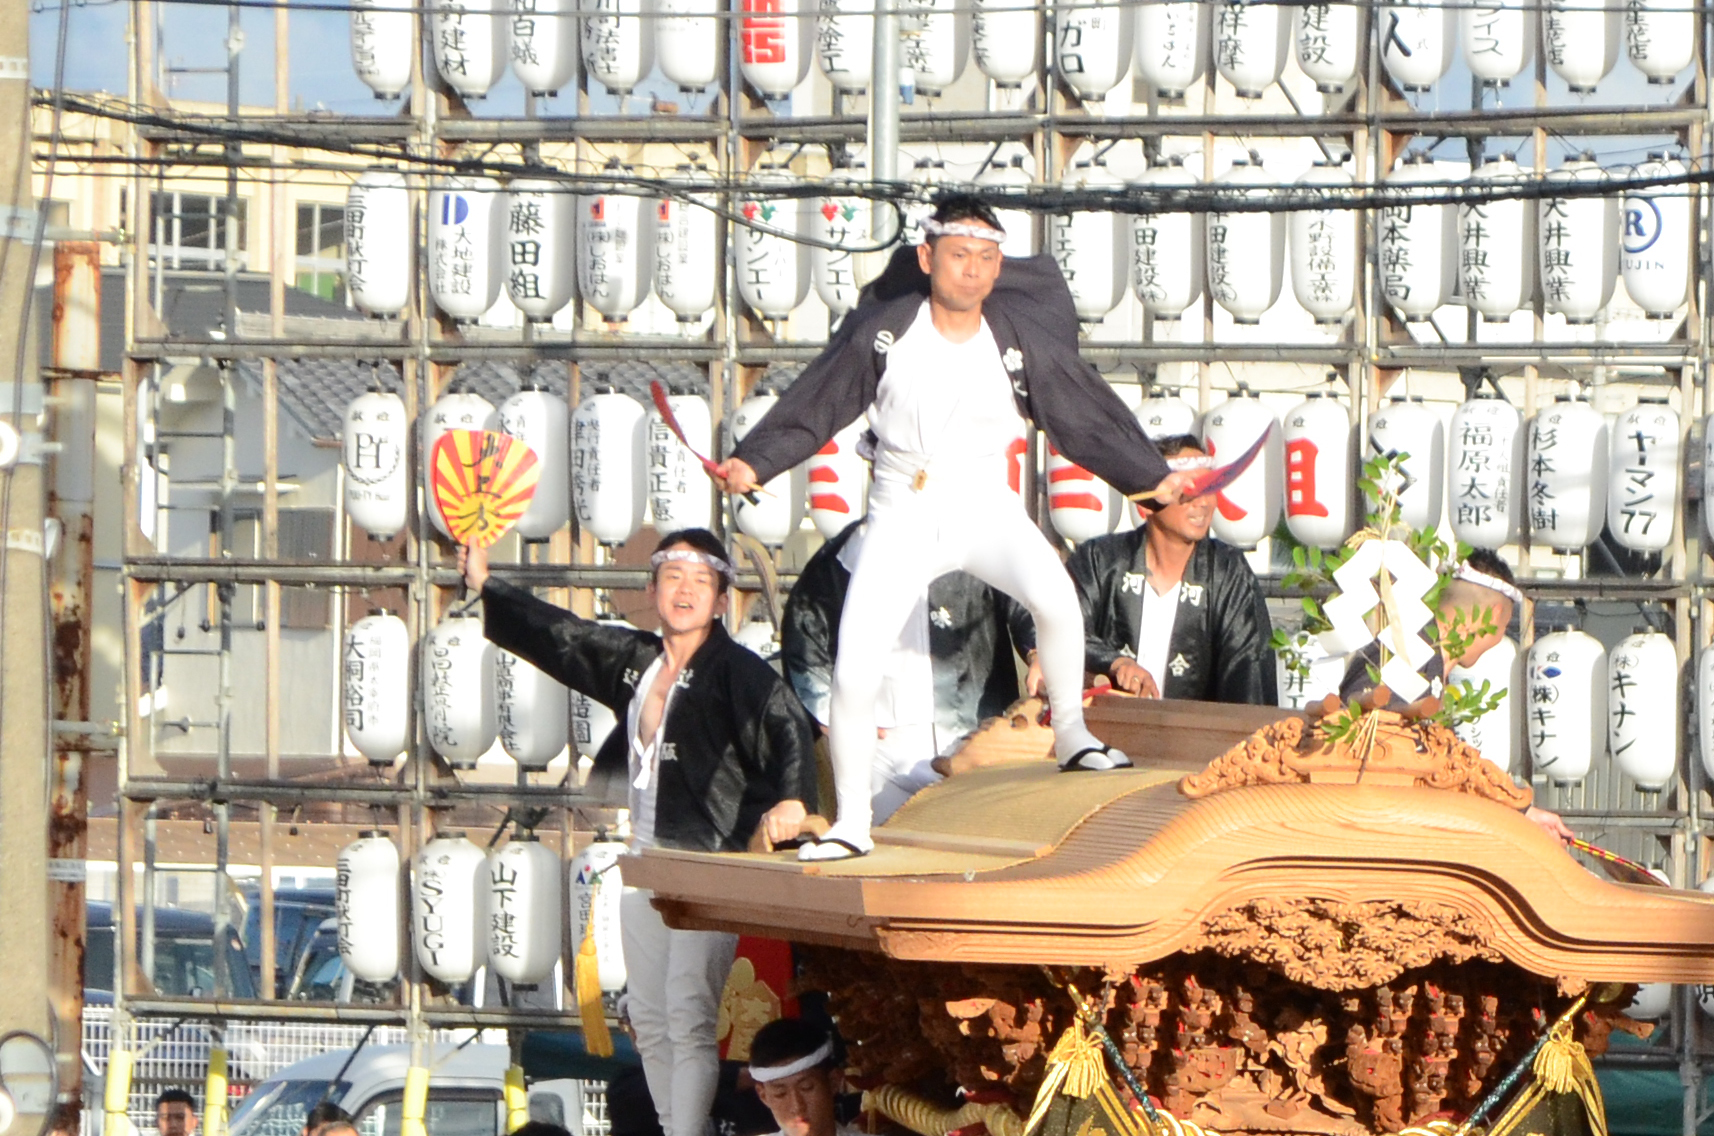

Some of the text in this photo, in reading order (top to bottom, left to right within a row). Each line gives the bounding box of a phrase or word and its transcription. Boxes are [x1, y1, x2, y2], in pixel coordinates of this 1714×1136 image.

[509, 200, 547, 300] 藤田組
[1457, 421, 1493, 526] 福原太郎
[1531, 426, 1559, 531] 杉本冬樹
[491, 861, 521, 959] 山下建設
